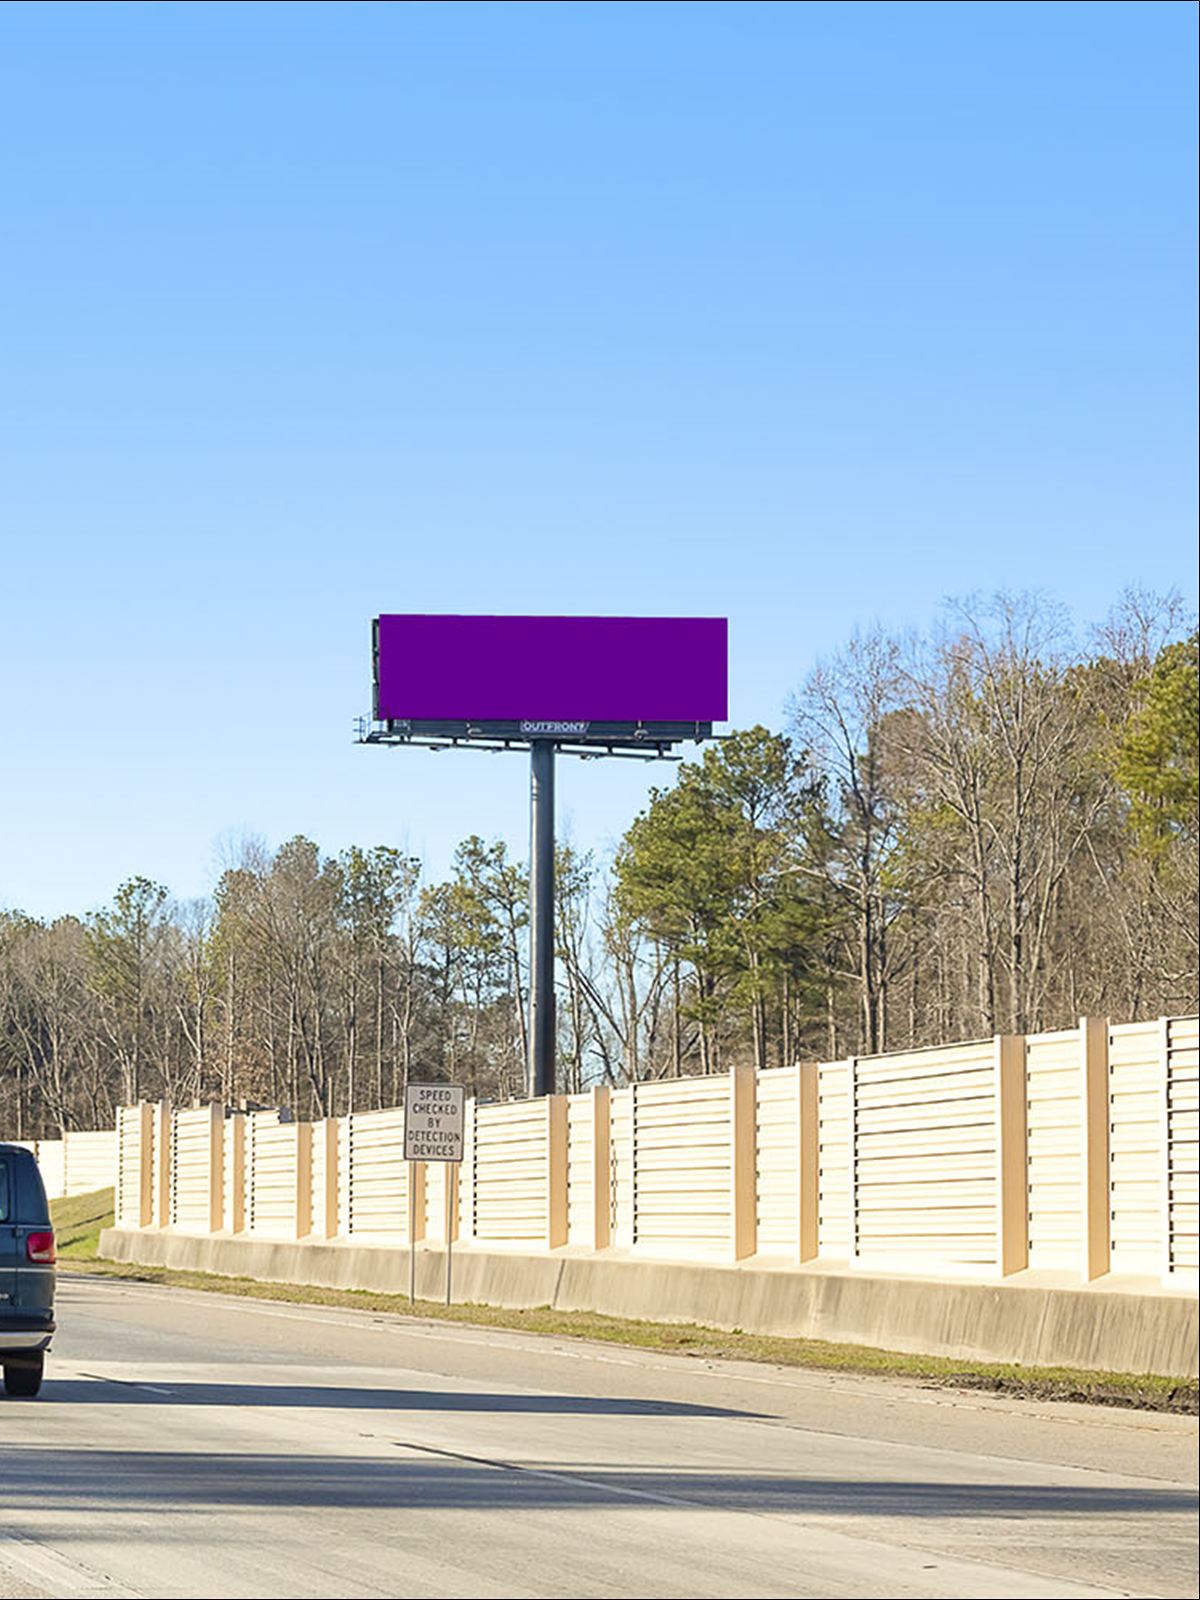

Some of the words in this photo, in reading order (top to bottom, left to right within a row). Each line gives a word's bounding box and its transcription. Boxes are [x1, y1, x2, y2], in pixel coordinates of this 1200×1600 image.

[523, 721, 586, 731] OUTFRONT
[419, 1089, 452, 1101] SPEED
[412, 1103, 457, 1115] CHECKED
[427, 1117, 441, 1128] BY
[408, 1130, 460, 1142] DETECTION
[413, 1144, 454, 1156] DEVICES
